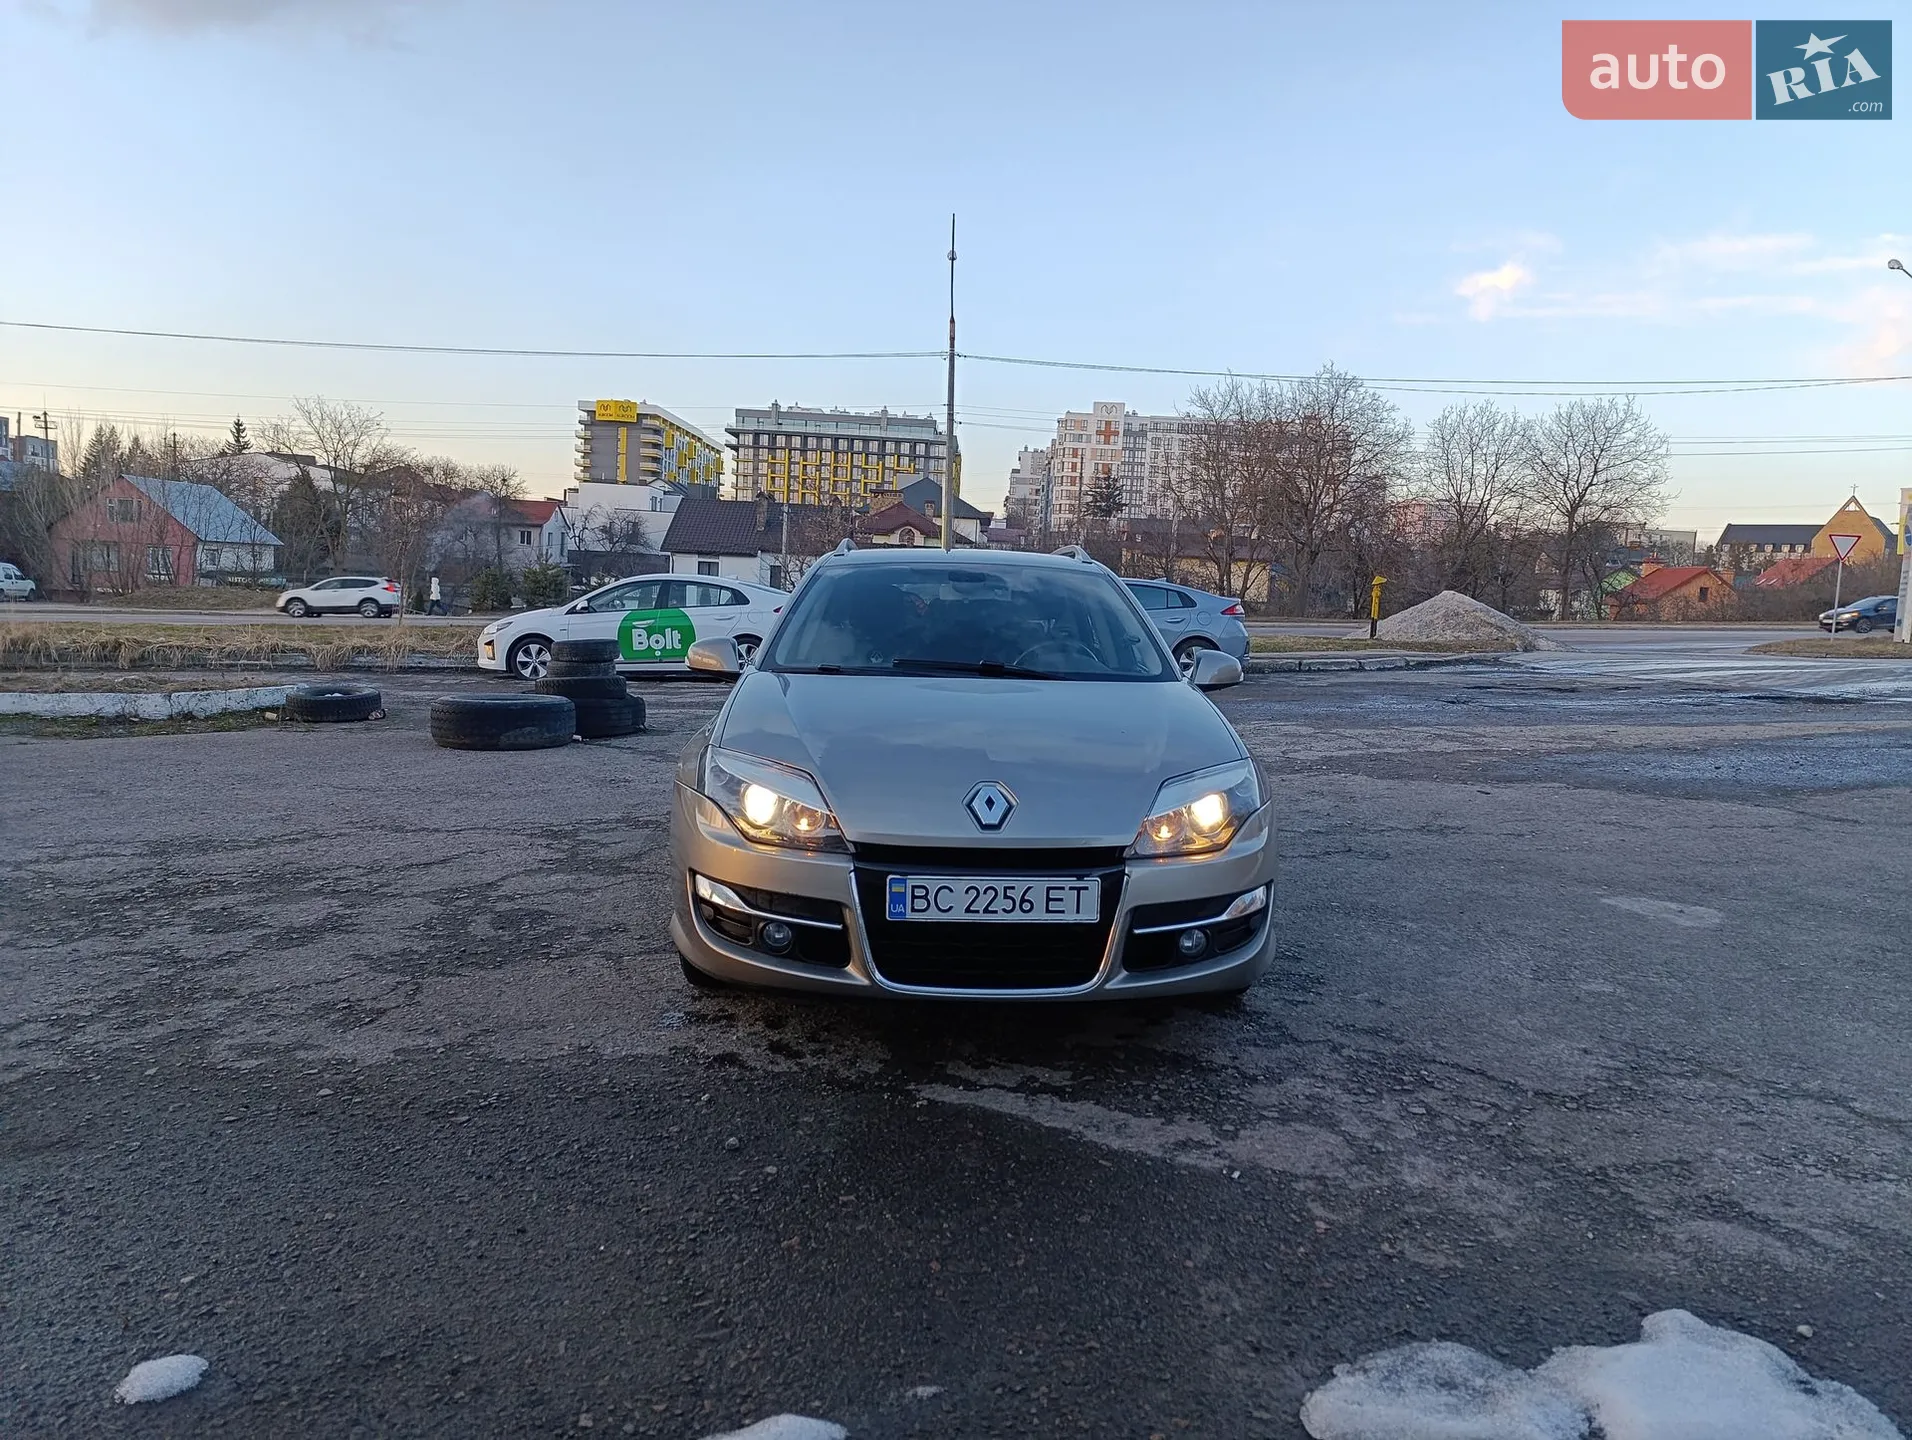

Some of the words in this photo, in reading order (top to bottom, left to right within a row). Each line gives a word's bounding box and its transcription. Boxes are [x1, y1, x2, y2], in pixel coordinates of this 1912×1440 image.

[632, 627, 681, 651] Bolt
[891, 903, 905, 913] UA
[910, 884, 954, 913] BC
[964, 885, 1035, 914] 2256
[1045, 886, 1089, 914] ET
